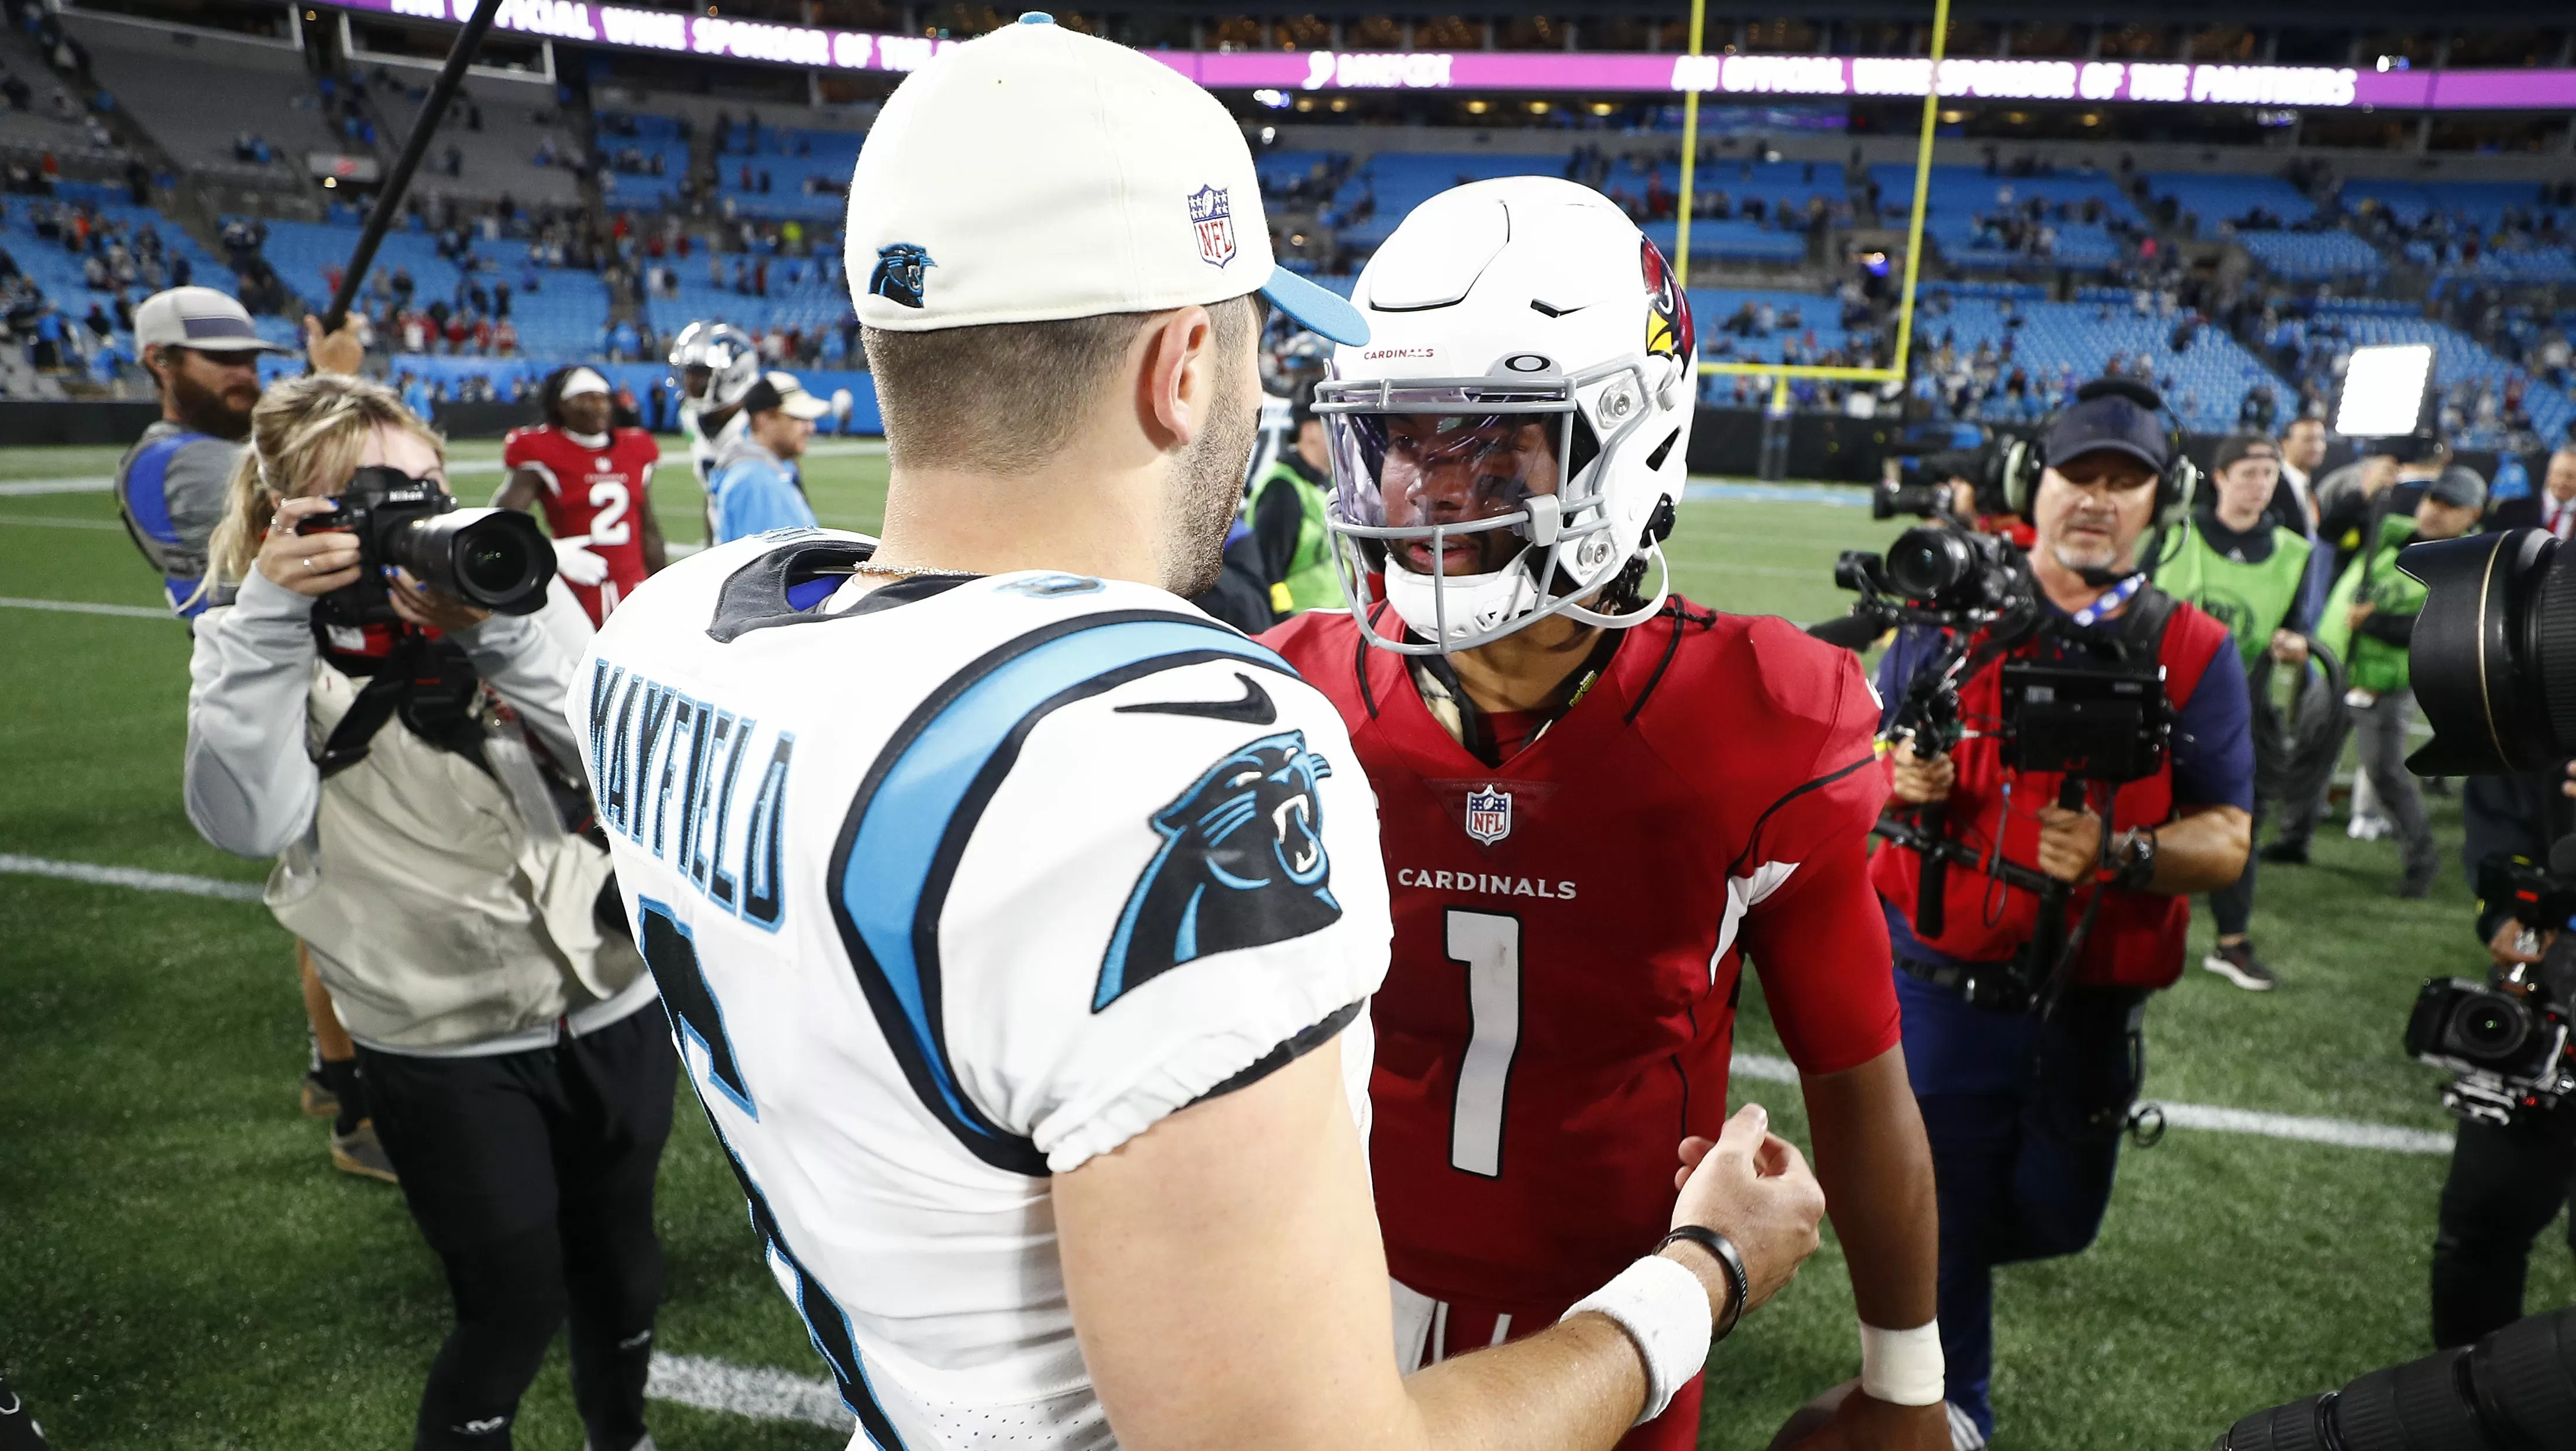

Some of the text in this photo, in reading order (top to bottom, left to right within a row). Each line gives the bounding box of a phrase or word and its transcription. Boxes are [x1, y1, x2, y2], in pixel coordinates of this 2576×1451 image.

[600, 6, 687, 51] WINE
[692, 18, 830, 66] SPONSOR
[833, 32, 873, 68] OF
[2080, 61, 2125, 100] OF
[2190, 64, 2358, 105] PANTHERS
[1198, 220, 1232, 259] NFL
[1363, 348, 1434, 360] CARDINALS
[589, 481, 631, 546] 2
[590, 657, 796, 935] MAYFIELD
[1474, 812, 1504, 834] NFL
[1397, 868, 1578, 900] CARDINALS
[1443, 905, 1523, 1180] 1
